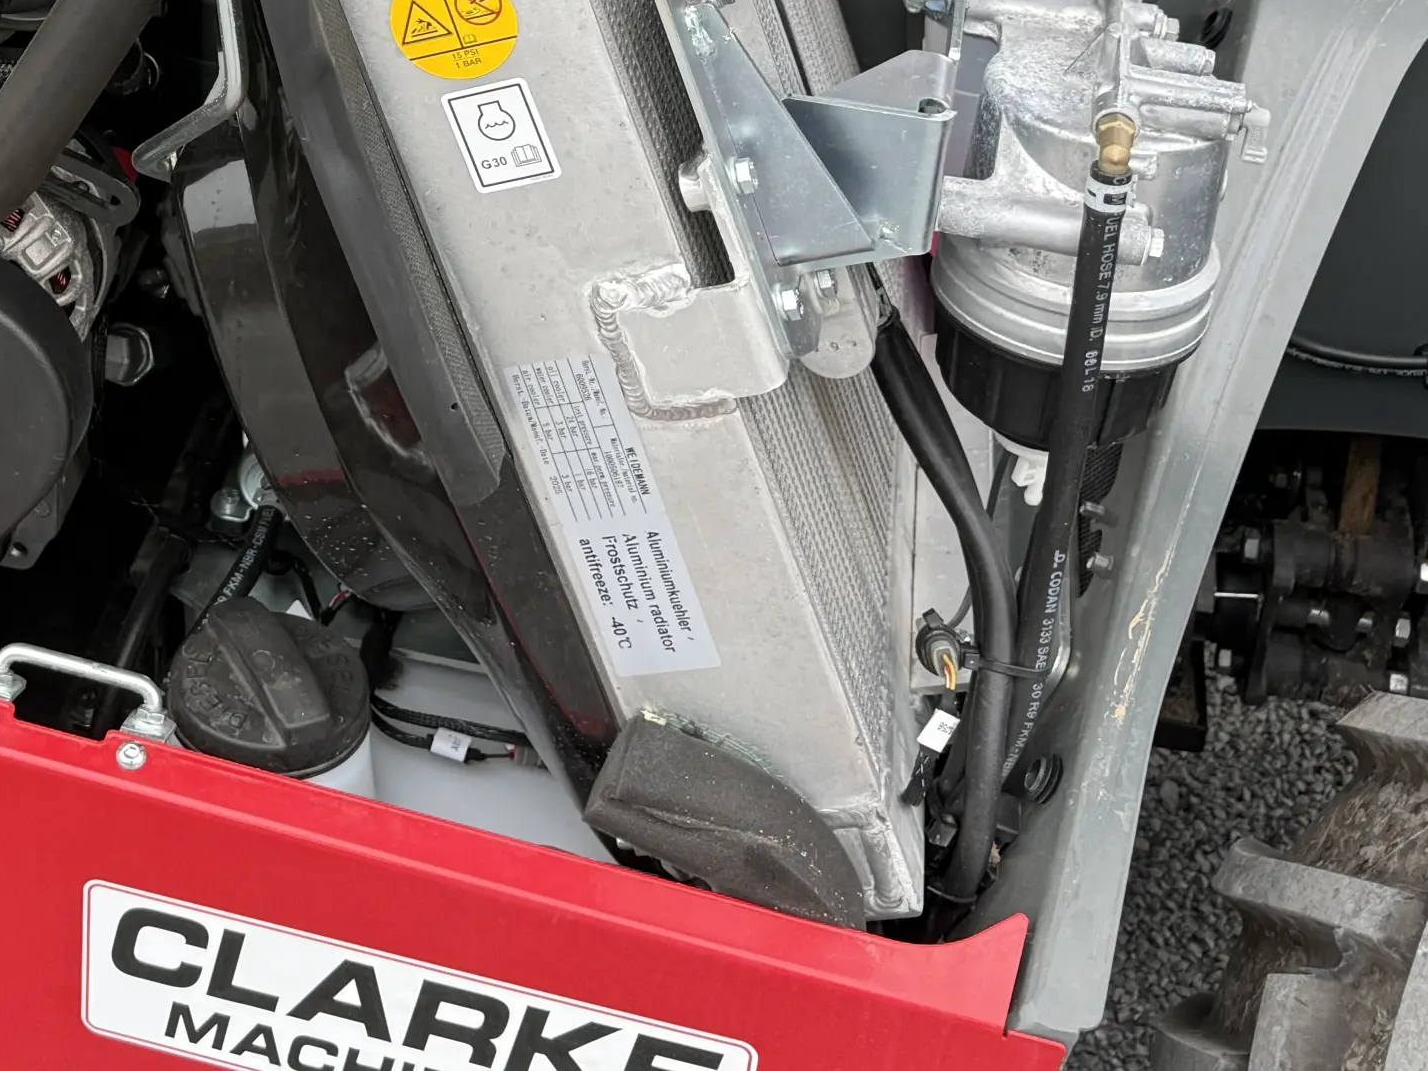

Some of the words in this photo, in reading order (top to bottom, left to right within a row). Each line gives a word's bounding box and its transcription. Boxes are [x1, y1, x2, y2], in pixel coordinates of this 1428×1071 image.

[452, 51, 463, 60] 15
[464, 48, 479, 58] PSI
[463, 57, 482, 68] BAR
[481, 156, 508, 170] G30
[1103, 212, 1118, 241] UEL
[1098, 243, 1114, 280] HOSE
[1095, 282, 1108, 300] 7.9
[1092, 302, 1104, 323] mm
[527, 383, 541, 406] cooler
[545, 428, 555, 441] bar
[563, 480, 574, 493] bar
[542, 384, 555, 405] cooler
[558, 426, 567, 439] bar
[576, 478, 587, 491] bar
[553, 379, 566, 402] cooler
[570, 425, 579, 438] bar
[588, 477, 598, 490] bar
[624, 446, 651, 495] WEIDEMANN
[579, 537, 613, 606] antifreeze:
[602, 535, 638, 610] Frostschutz
[645, 530, 692, 632] Aluminiumkuehler
[622, 533, 657, 600] Aluminium
[649, 604, 676, 652] radiator
[1045, 571, 1064, 614] CODAN
[1040, 618, 1055, 645] 3133
[1035, 647, 1050, 670] SAE
[1029, 681, 1044, 700] 30
[164, 1001, 457, 1071] MACH
